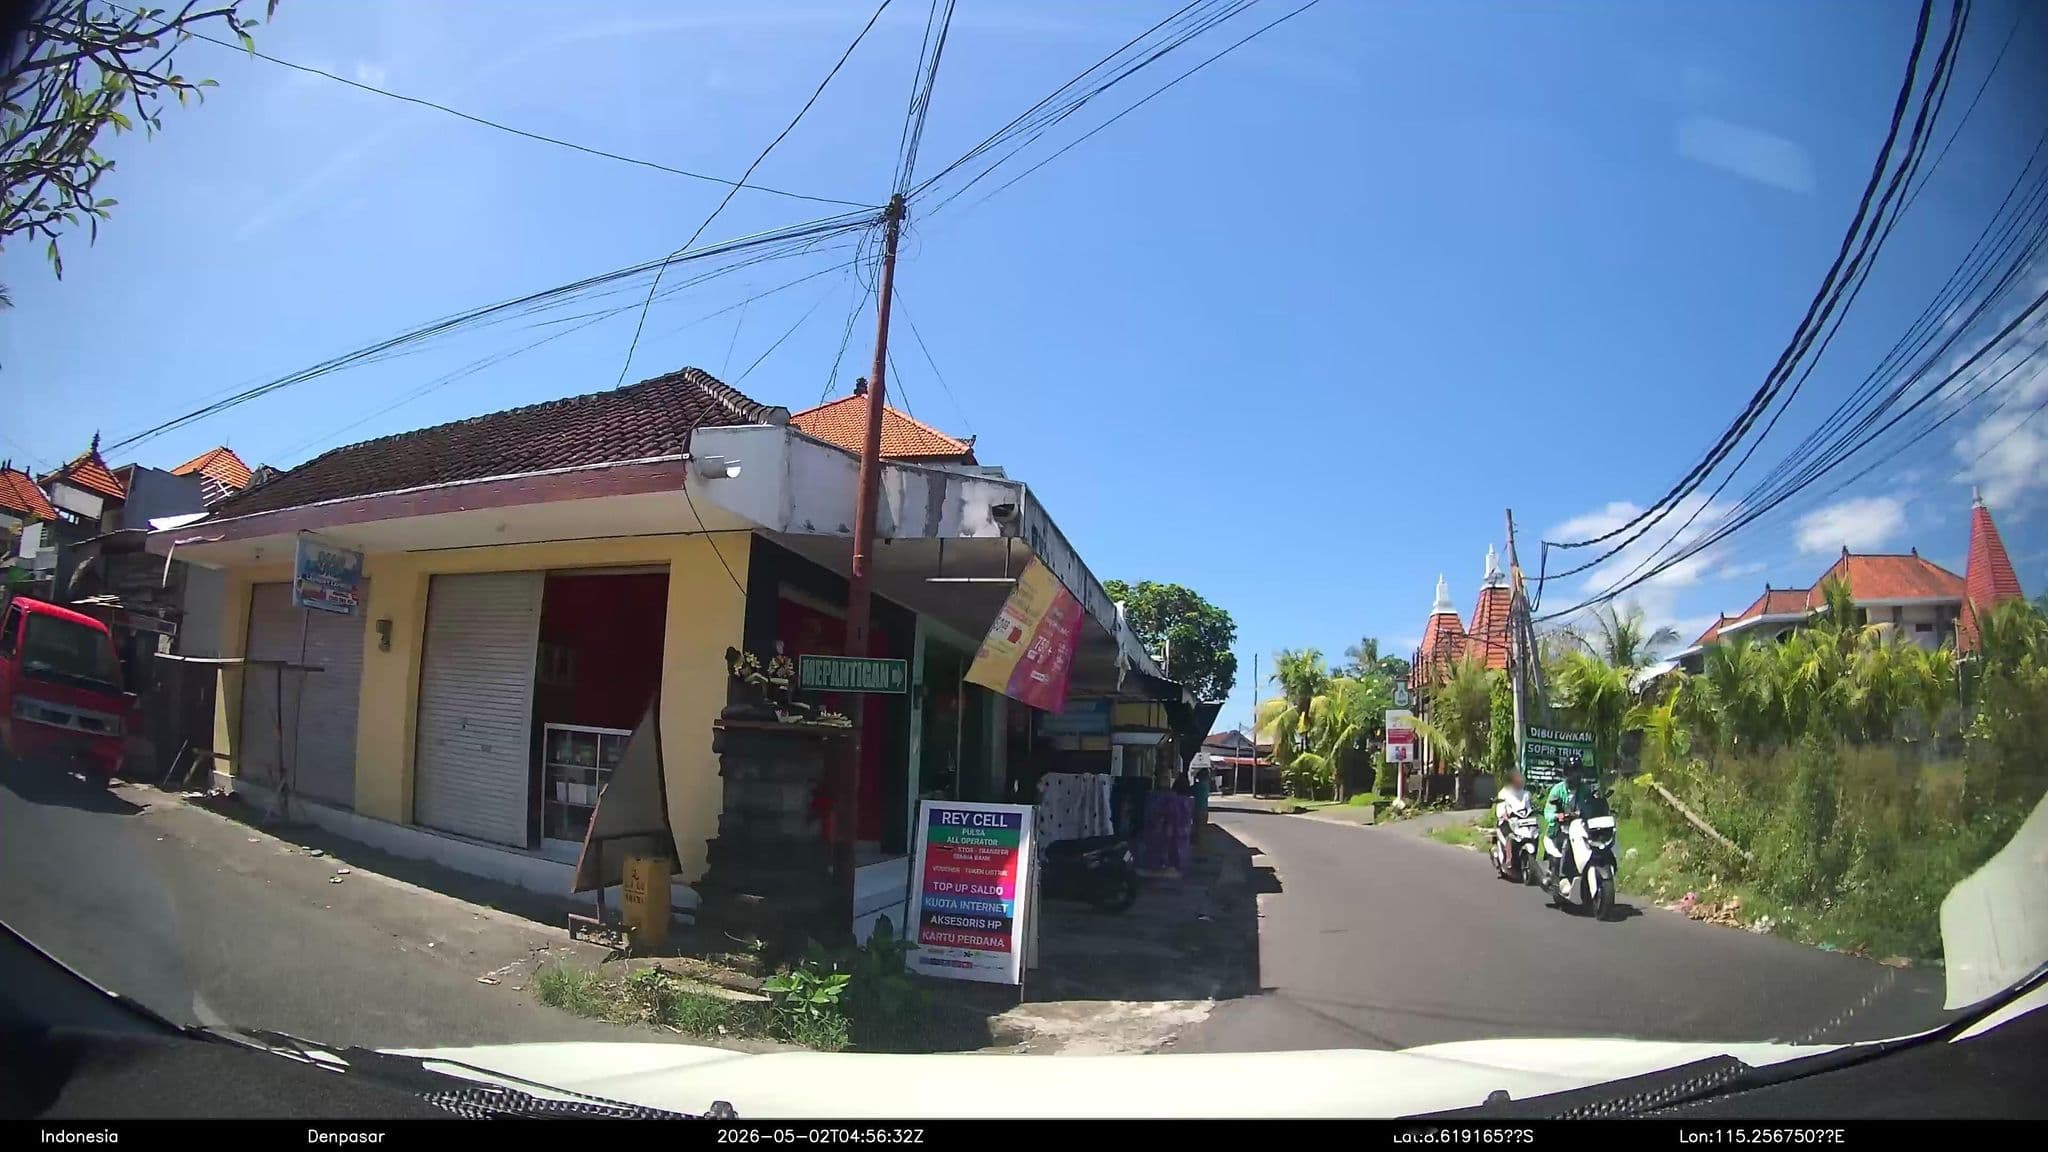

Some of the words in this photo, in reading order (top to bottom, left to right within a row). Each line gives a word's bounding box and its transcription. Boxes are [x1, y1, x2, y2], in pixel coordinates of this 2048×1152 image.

[1530, 727, 1592, 742] DIBUTUHKAN
[1527, 743, 1556, 756] SOPIR
[1557, 747, 1583, 758] TRUK
[942, 811, 968, 825] REY
[973, 814, 1008, 827] CELL
[962, 828, 985, 837] PULSA
[946, 836, 960, 844] ALL
[960, 837, 998, 846] OPERATOR
[933, 881, 953, 891] TOP
[955, 884, 969, 893] UP
[970, 885, 1004, 896] SALDO
[925, 896, 957, 908] KUOTA
[959, 900, 1009, 913] INTERNET
[930, 915, 985, 928] AKSESORIS
[987, 920, 1002, 930] HP
[922, 931, 956, 943] KARTU
[957, 934, 1005, 947] PERDANA
